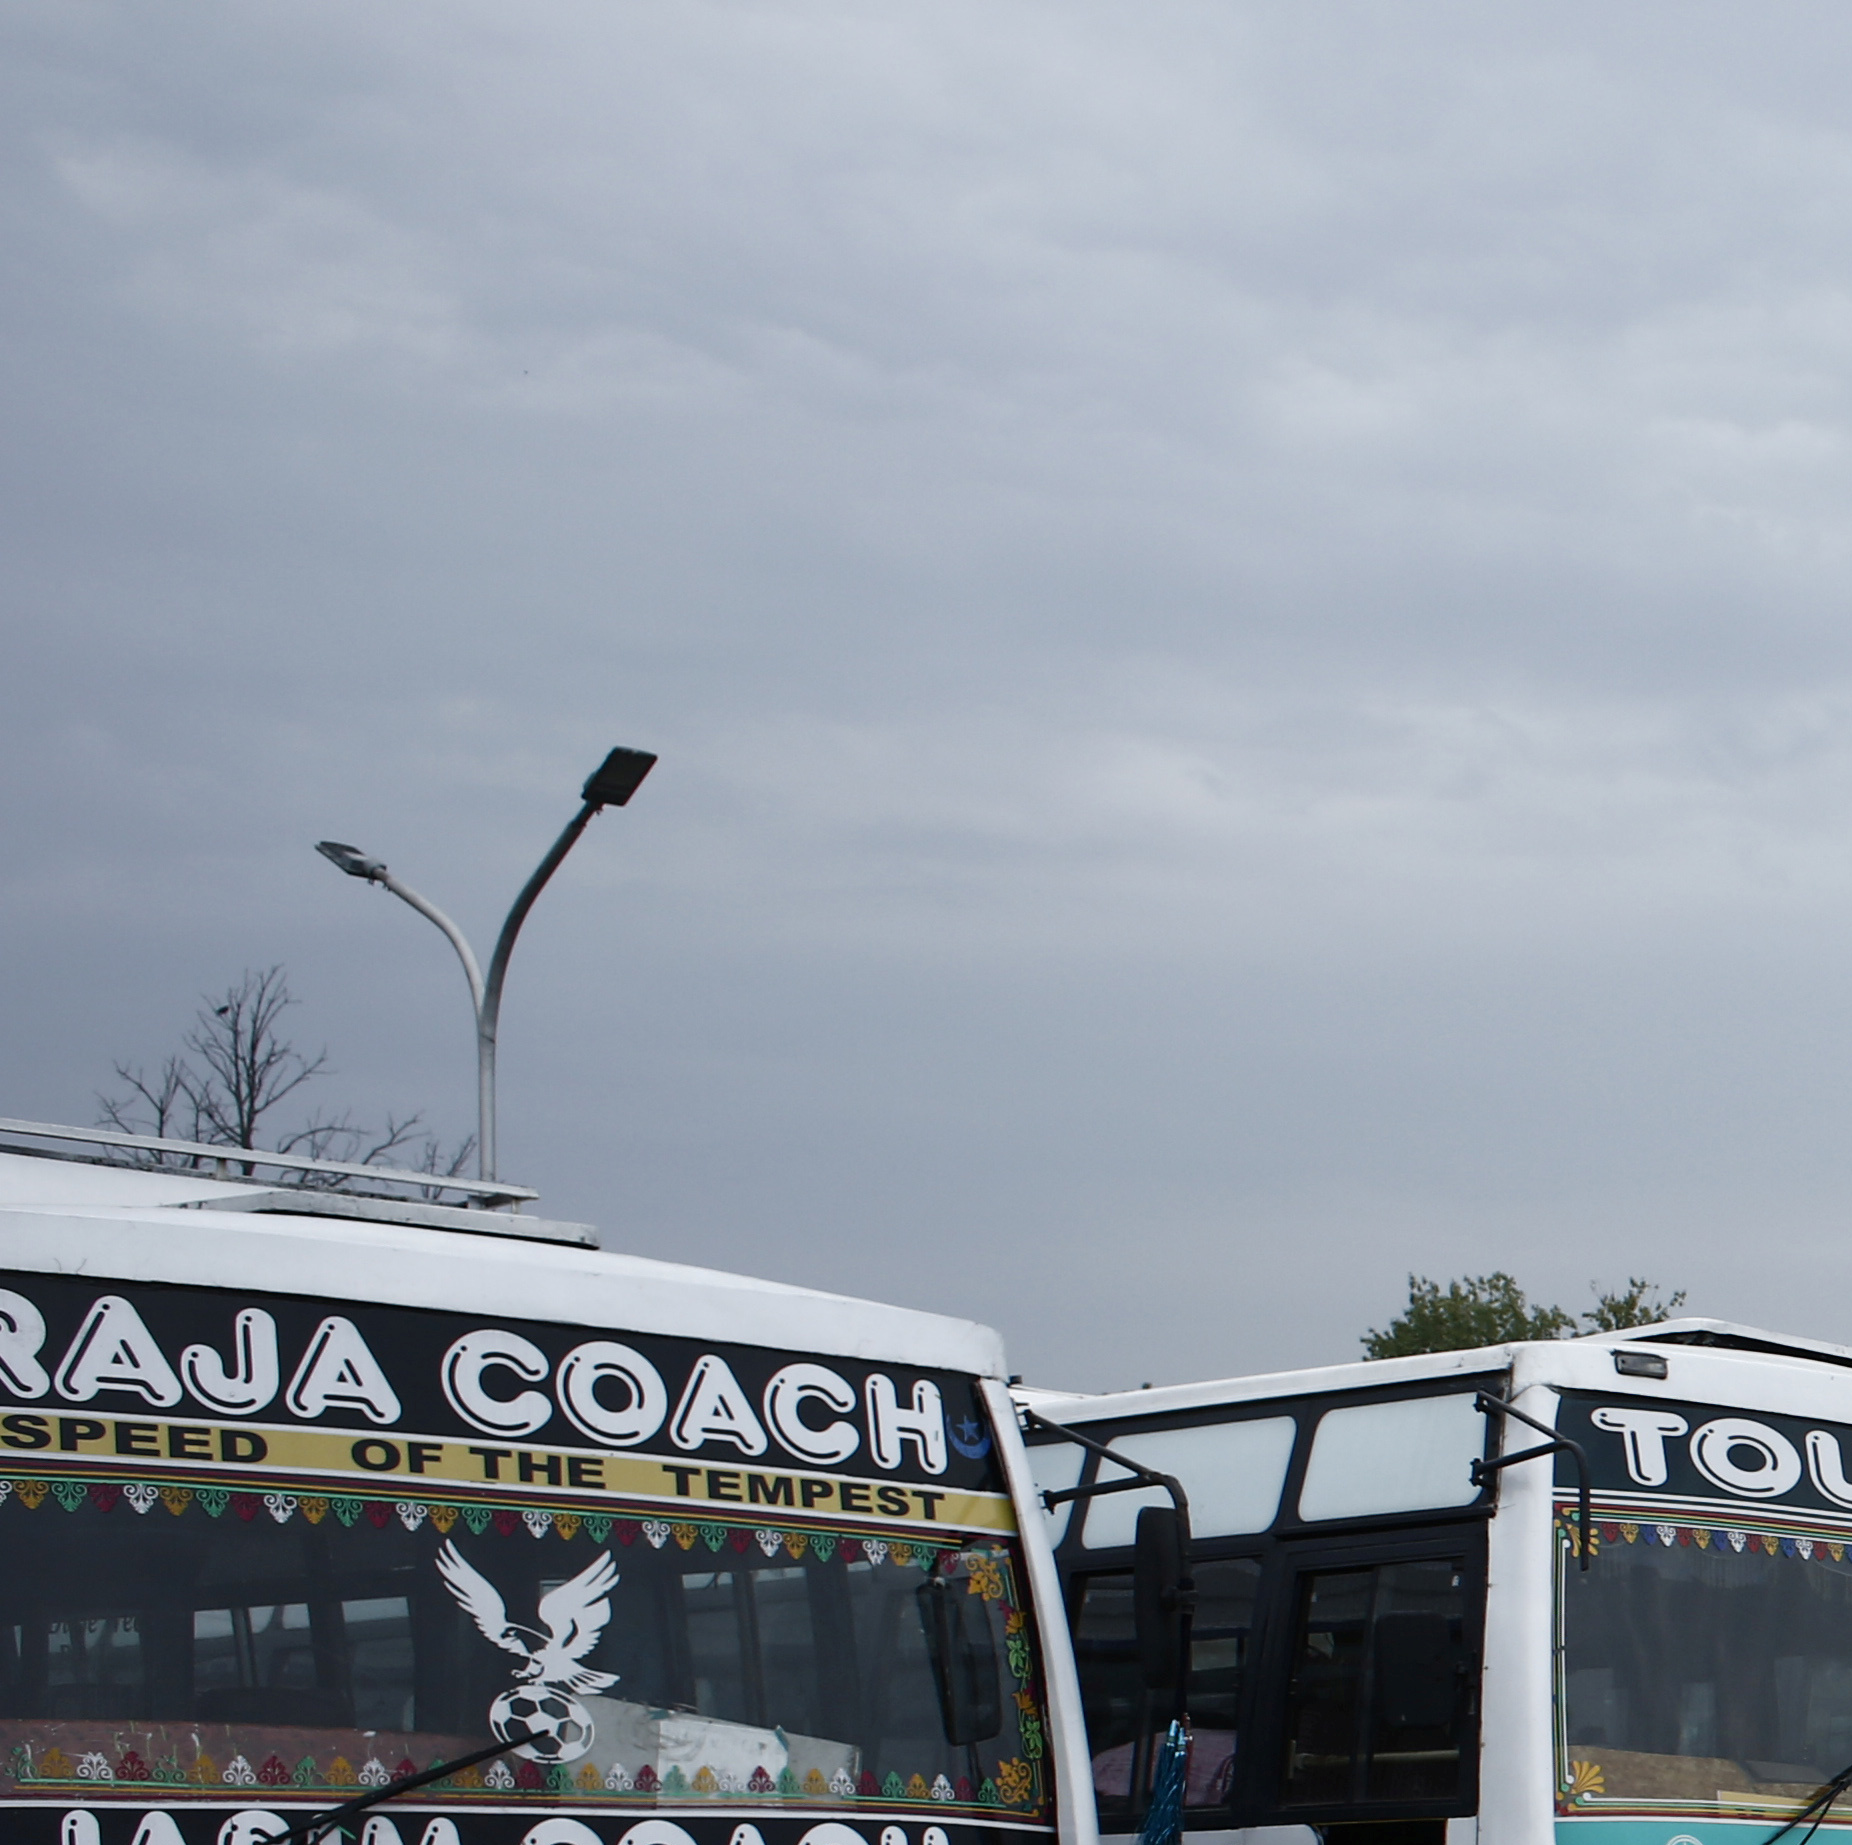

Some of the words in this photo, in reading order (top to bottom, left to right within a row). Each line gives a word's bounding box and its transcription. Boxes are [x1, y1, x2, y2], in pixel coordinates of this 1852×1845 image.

[440, 1328, 953, 1476] COACH
[1, 1414, 268, 1464] SPEED
[351, 1436, 444, 1477] OF
[469, 1446, 608, 1490] THE
[663, 1464, 948, 1524] TEMPEST
